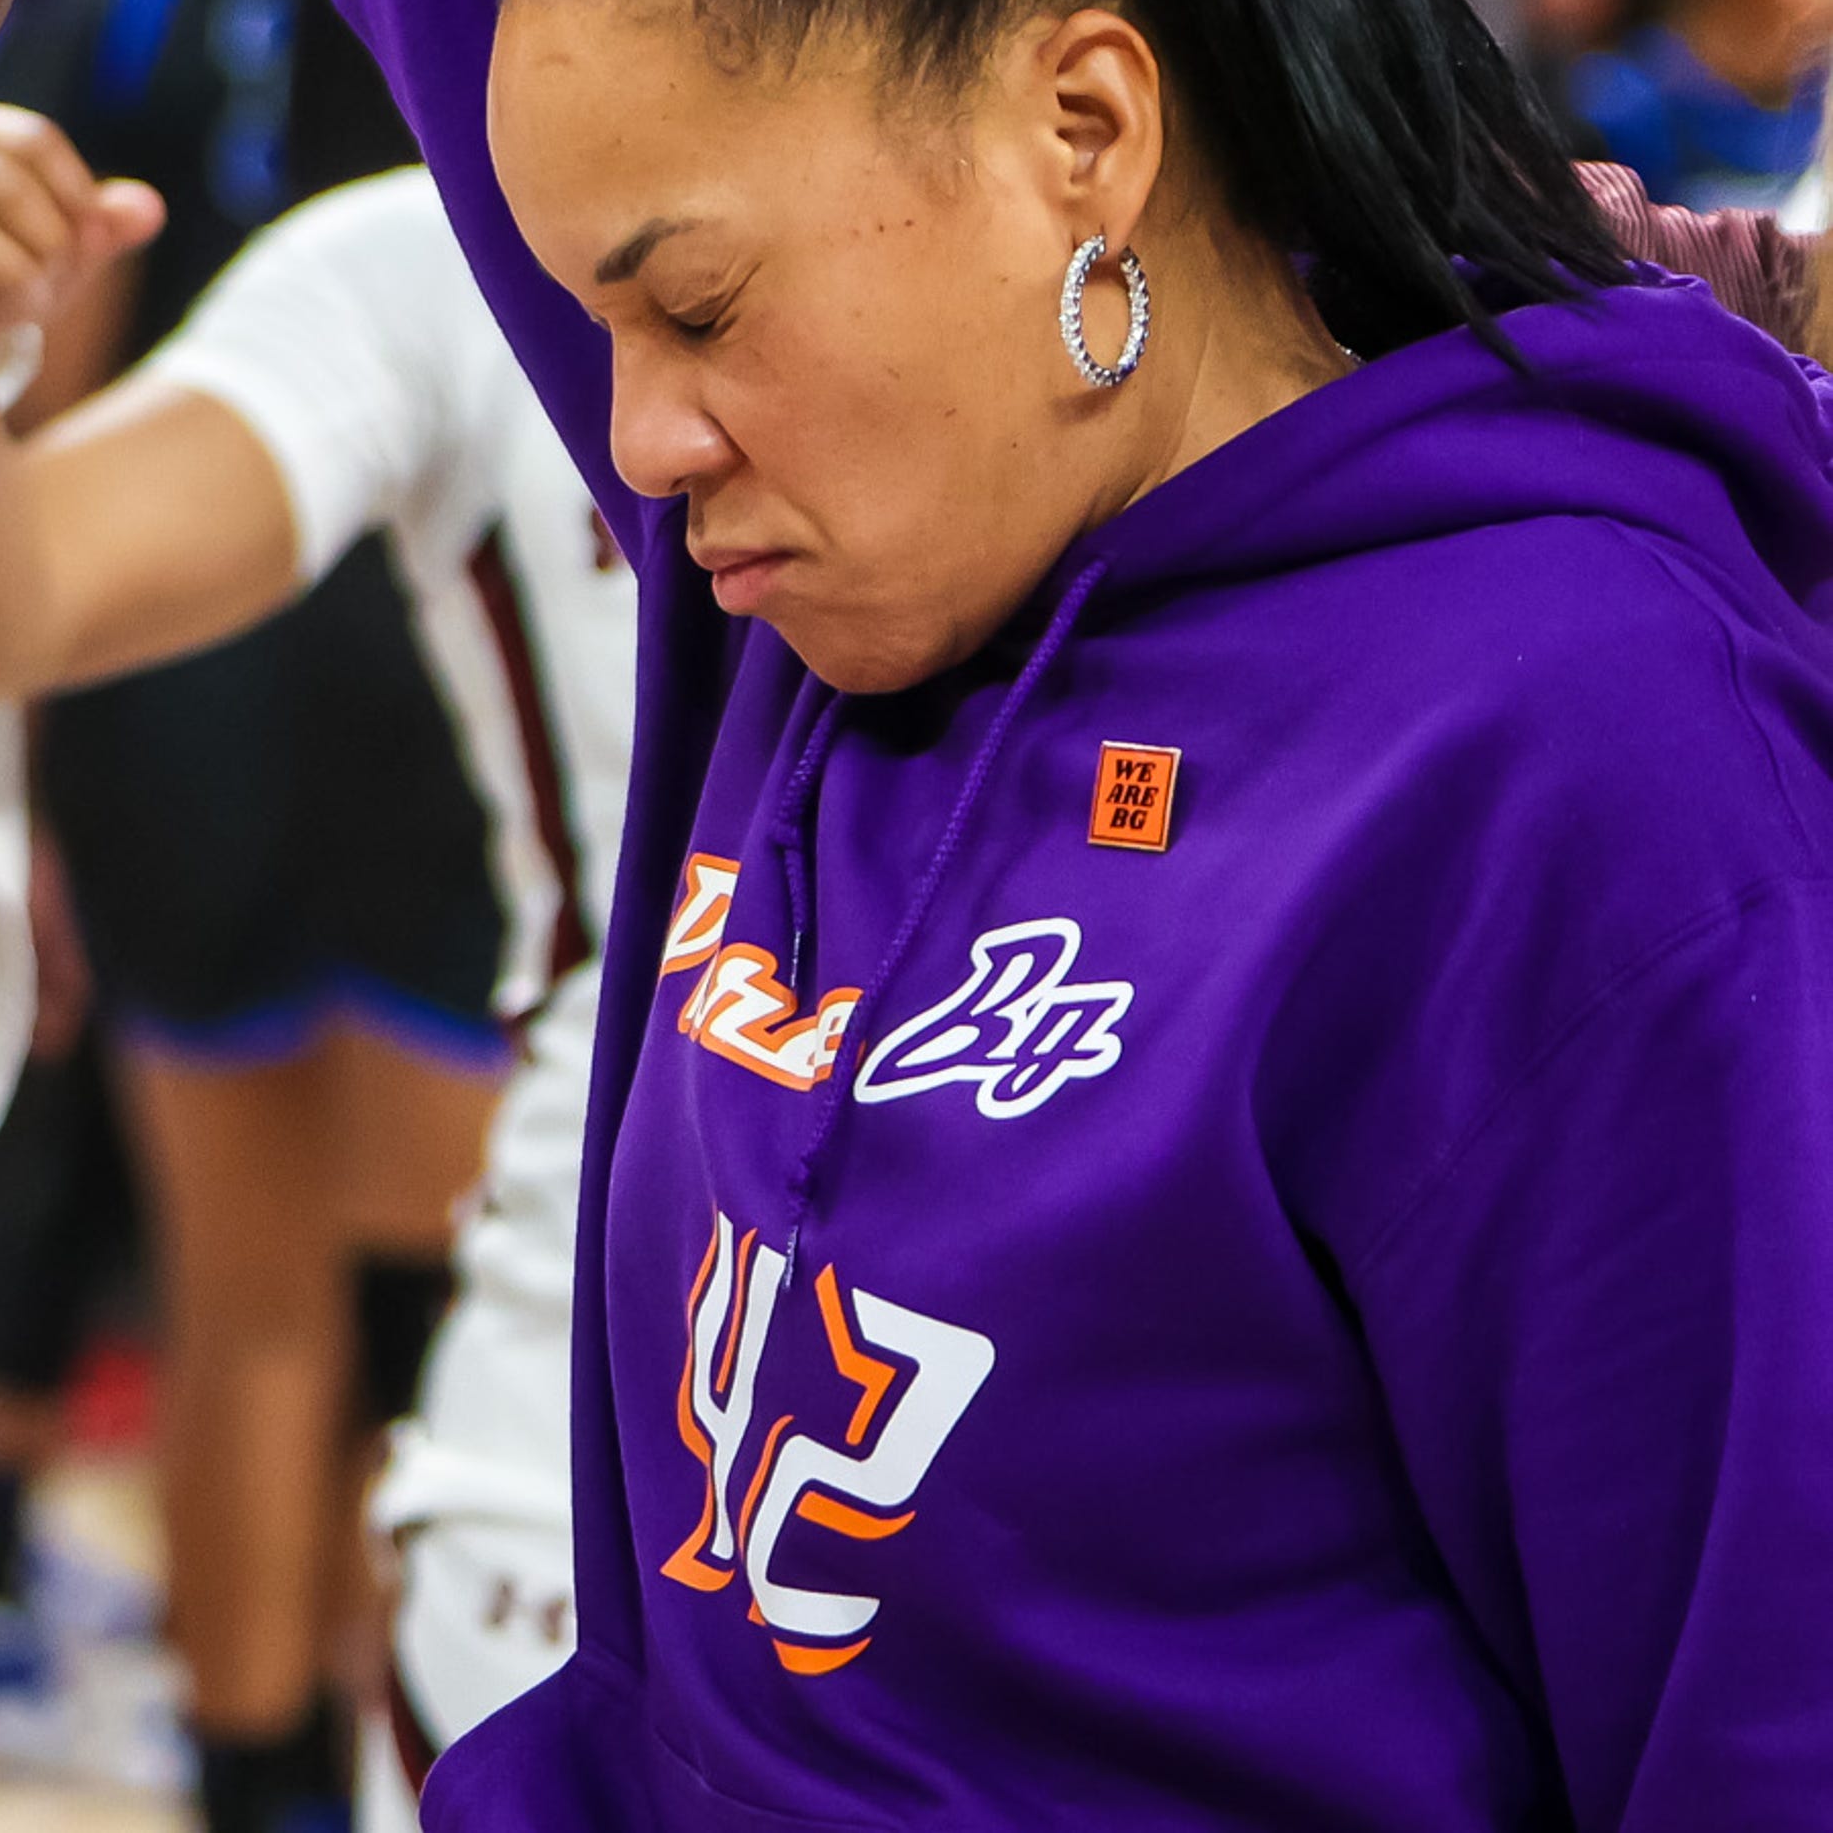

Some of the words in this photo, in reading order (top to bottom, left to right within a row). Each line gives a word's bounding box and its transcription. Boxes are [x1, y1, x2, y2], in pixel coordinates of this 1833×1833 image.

[1115, 758, 1157, 783] WE
[1105, 782, 1160, 809] ARE
[1109, 806, 1149, 831] BG
